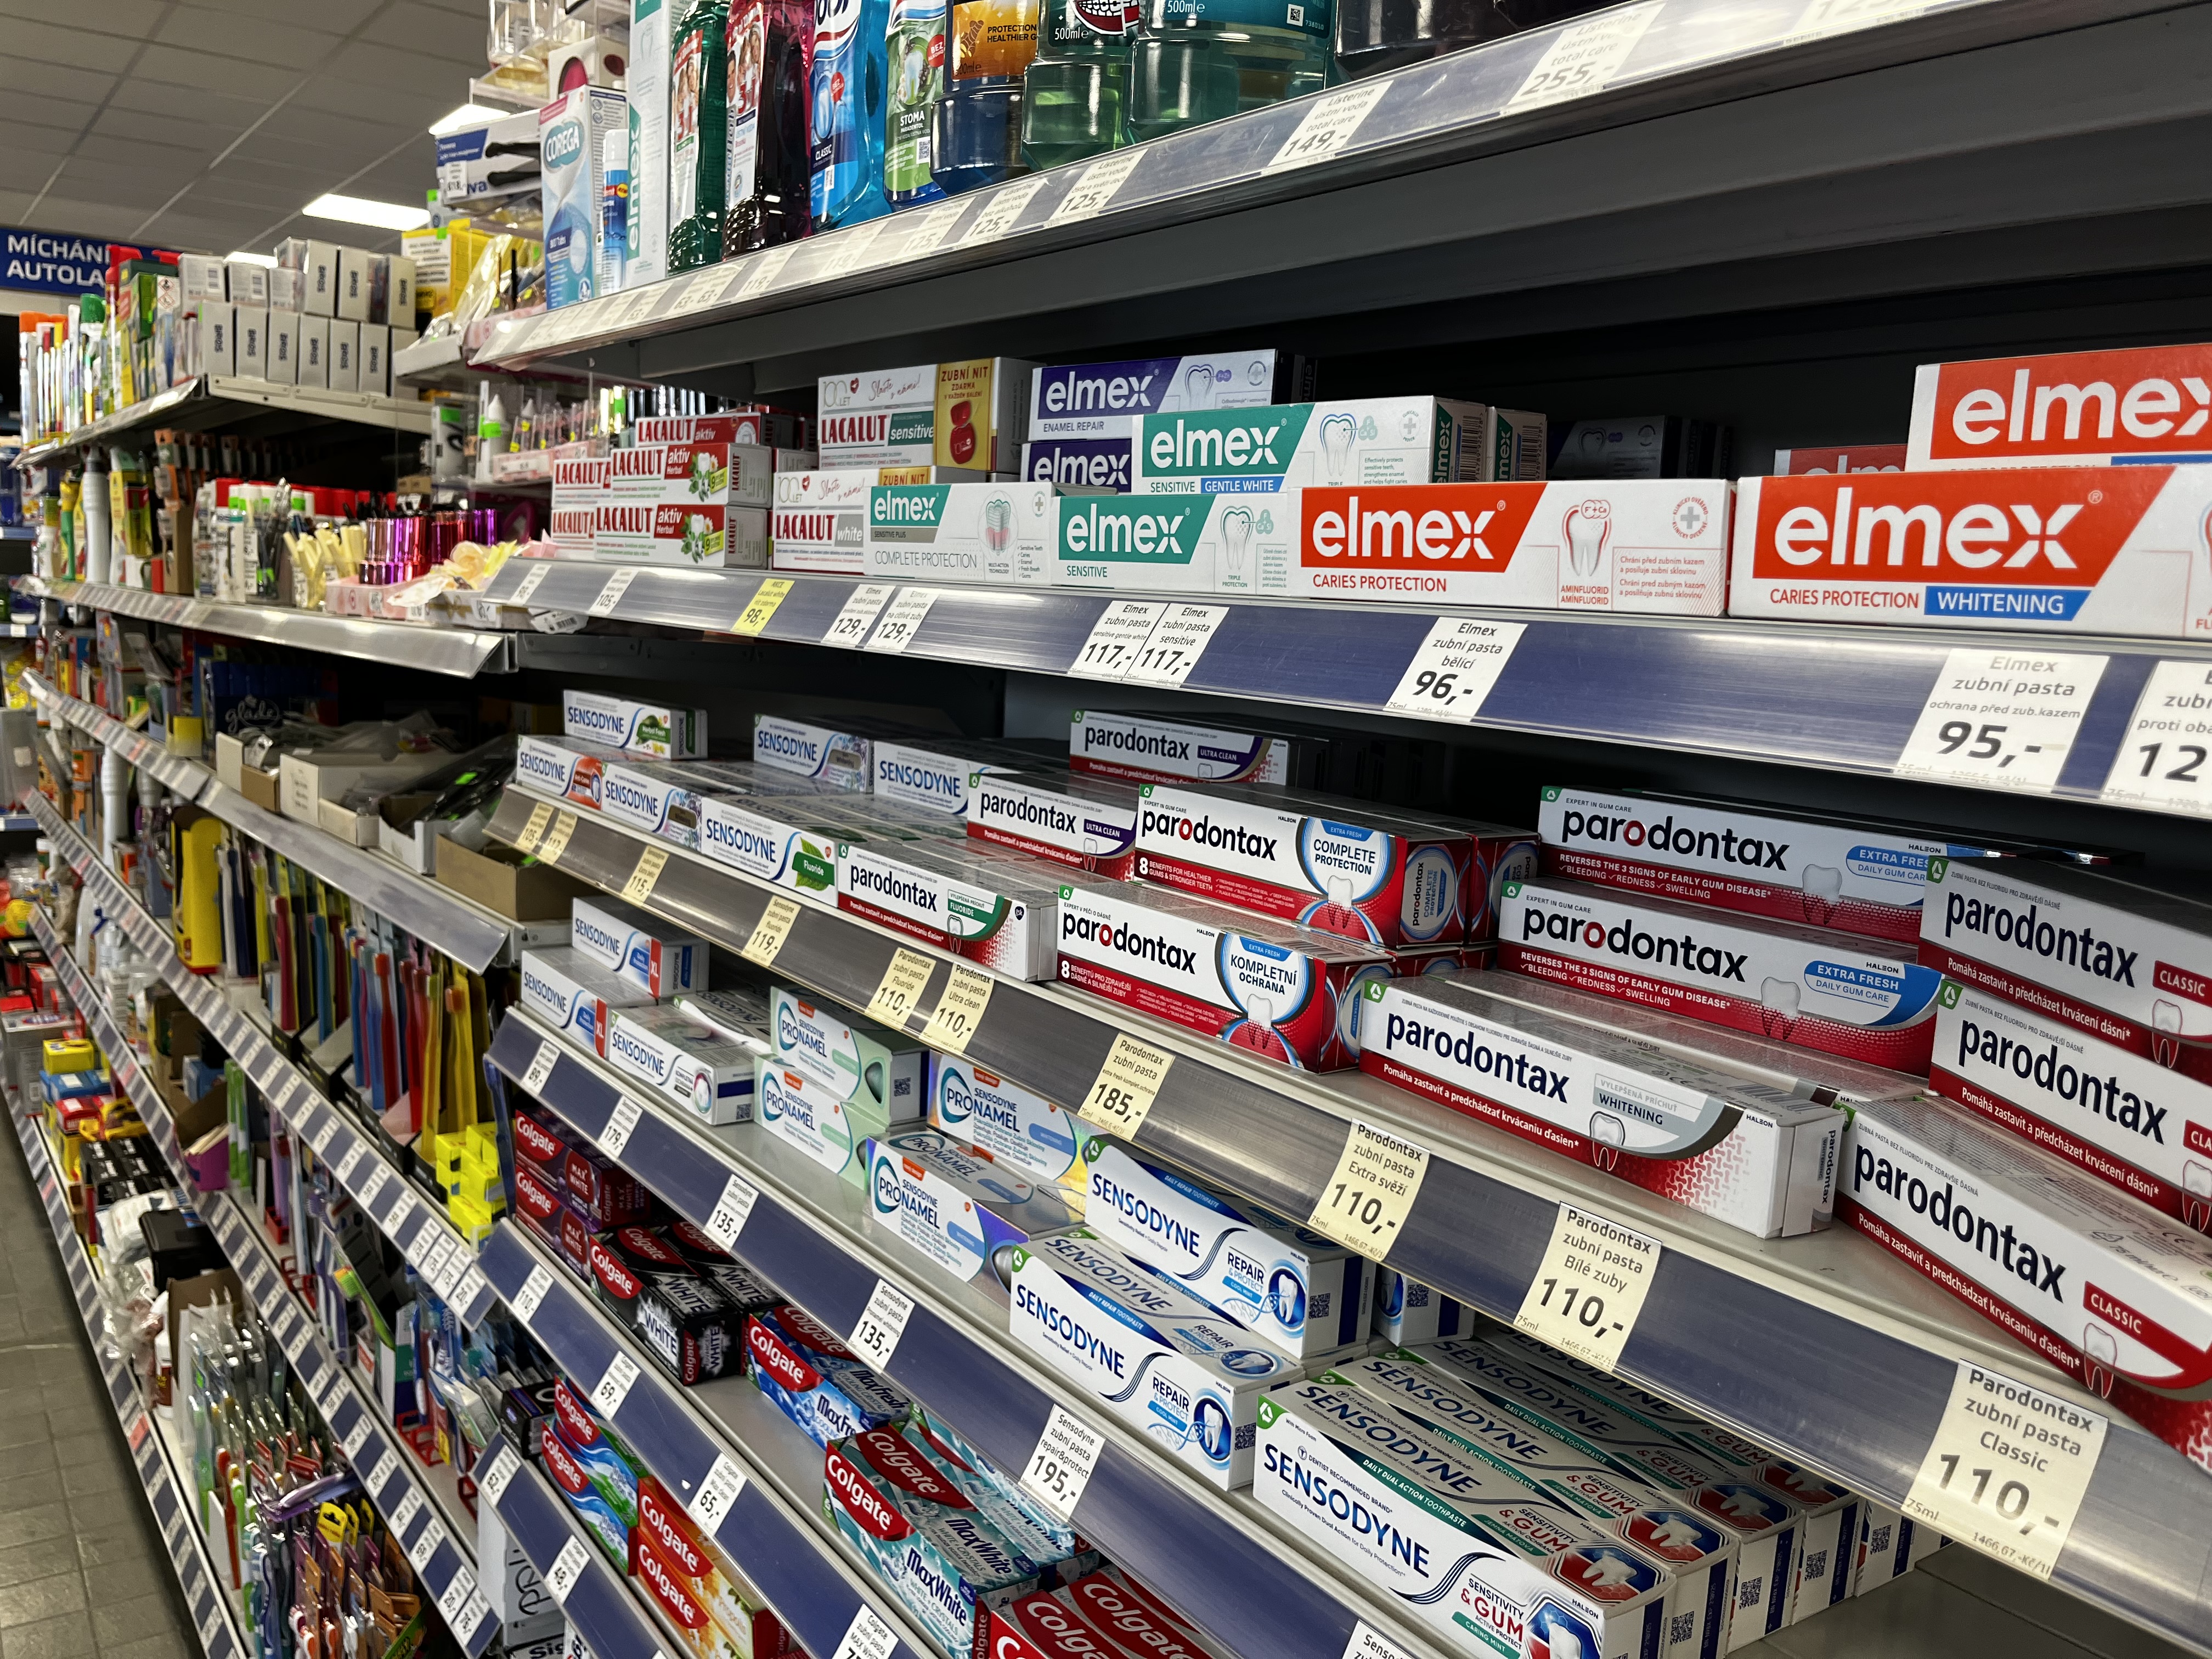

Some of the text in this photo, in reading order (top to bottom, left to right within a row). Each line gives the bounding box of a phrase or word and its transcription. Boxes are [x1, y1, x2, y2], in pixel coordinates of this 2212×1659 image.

[987, 32, 1029, 43] HEALTHIER
[988, 24, 1036, 33] PROTECTION
[1577, 12, 1643, 36] Listerine
[1550, 42, 1618, 67] total care
[1521, 61, 1615, 97] 255,-
[1328, 87, 1375, 107] Listerine
[900, 110, 924, 126] STOMA
[545, 124, 581, 164] COREGA
[1284, 129, 1347, 157] 149,-
[628, 120, 641, 251] elmex
[1061, 191, 1109, 213] 125,-
[7, 259, 105, 289] AUTOLA
[941, 366, 988, 382] ZUBNÍ NIT
[639, 419, 716, 442] LACALUT aktiv
[822, 415, 934, 444] LACALUT sensitive
[1043, 421, 1104, 432] ENAMEL REPAIR
[1150, 419, 1280, 469] elmex
[555, 463, 603, 485] LACALUT
[613, 449, 690, 476] LACALUT aktiv
[1150, 480, 1274, 493] SENSITIVE GENTLE WHITE
[596, 507, 682, 533] LACALUT aktiv
[873, 496, 936, 522] elmex
[776, 514, 862, 542] LACALUT white
[1066, 504, 1184, 554] elmex
[1312, 496, 1496, 560] elmex
[1775, 487, 2084, 569] elmex
[876, 551, 977, 568] COMPLETE PROTECTION
[1067, 566, 1108, 578] SENSITIVE
[1312, 574, 1447, 592] CARIES PROTECTION
[1561, 585, 1609, 595] AMINFLUORID
[1123, 605, 1149, 614] Elmex
[1181, 607, 1209, 618] Elmex
[1770, 589, 2063, 614] CARIES PROTECTION WHITENING
[1159, 635, 1196, 646] sensitive
[1432, 638, 1503, 654] zubní pasta
[1457, 623, 1498, 636] Elmex
[1441, 655, 1477, 669] bělící
[1989, 655, 2059, 673] Elmex
[1412, 670, 1474, 706] 96,-
[1951, 678, 2076, 697] zubní pasta
[568, 707, 625, 735] SENSODYNE
[758, 730, 817, 763] SENSODYNE
[1200, 748, 1237, 761] ULTRA CLEAN
[1937, 720, 2042, 768] 95,-
[520, 752, 565, 783] SENSODYNE
[879, 760, 961, 798] SENSODYNE
[606, 780, 658, 817] SENSODYNE
[706, 818, 777, 864] SENSODYNE
[1086, 822, 1120, 838] ULTRA CLEAN
[1561, 809, 1790, 872] parodontax
[804, 859, 824, 877] Fluoride
[1313, 839, 1376, 864] COMPLETE
[1315, 854, 1372, 875] PROTECTION
[851, 864, 937, 912] parodontax
[1560, 854, 1601, 867] REVERSES
[1604, 862, 1620, 871] THE
[1629, 866, 1656, 878] SIGNS
[1657, 871, 1669, 879] OF
[1672, 873, 1700, 886] EARLY
[1702, 879, 1724, 890] GUM
[1567, 866, 1711, 899] BLEEDING REDNESS SWELLING
[950, 902, 974, 917] FLUORIDE
[1249, 944, 1280, 958] EXTRA FRESH
[1523, 907, 1748, 983] parodontax
[1945, 891, 2138, 989] parodontax
[956, 964, 991, 984] Parodontax
[1231, 953, 1299, 986] KOMPLETNÍ
[1239, 973, 1285, 996] OCHRANA
[1818, 964, 1899, 990] EXTRA FRESH
[2159, 970, 2206, 997] CLASSIC
[1816, 980, 1889, 1002] DAILY GUM CARE
[612, 1031, 665, 1077] SENSODYNE
[782, 1020, 827, 1059] PRONAMEL
[1120, 1040, 1164, 1066] Parodontax
[1113, 1055, 1158, 1080] zubní pasta
[1386, 1012, 1570, 1105] parodontax
[1958, 1019, 2168, 1146] parodontax
[766, 1091, 816, 1131] PRONAMEL
[946, 1087, 1020, 1134] PRONAMEL
[1094, 1084, 1142, 1123] 185,-
[1598, 1092, 1664, 1126] WHITENING
[1357, 1124, 1422, 1162] Parodontax
[1348, 1161, 1408, 1197] Extra svěží
[879, 1176, 940, 1230] PRONAMEL
[1092, 1173, 1200, 1257] SENSODYNE
[1331, 1183, 1396, 1234] 110,-
[1567, 1209, 1652, 1255] Parodontax
[1854, 1144, 2067, 1303] parodontax
[591, 1245, 633, 1295] Colgate
[1228, 1251, 1264, 1284] REPAIR
[1234, 1271, 1263, 1294] PROTECT
[1564, 1254, 1628, 1293] Bílé zuby
[1540, 1278, 1624, 1338] 110,-
[2091, 1293, 2142, 1334] CLASSIC
[646, 1313, 677, 1356] WHITE
[859, 1321, 890, 1357] 135,-
[1015, 1284, 1125, 1379] SENSODYNE
[750, 1324, 807, 1384] Colgate
[1153, 1375, 1189, 1412] REPAIR
[1969, 1368, 2094, 1433] Parodontax
[554, 1387, 594, 1443] Colgate
[1058, 1414, 1094, 1446] Sensodyne
[1964, 1397, 2082, 1457] zubní pasta
[542, 1434, 582, 1489] Colgate
[1040, 1438, 1089, 1479] repair&protect
[1050, 1427, 1091, 1461] zubní pasta
[1980, 1430, 2049, 1472] Classic
[867, 1432, 940, 1493] Colgate
[1034, 1455, 1076, 1501] 195,-
[827, 1454, 890, 1531] Colgate
[1363, 1459, 1466, 1528] DAILY DUAL ACTION TOOTHPASTE
[1939, 1453, 2060, 1536] 110,-
[1263, 1443, 1430, 1578] SENSODYNE
[1519, 1508, 1578, 1544] SENSITIVITY
[640, 1493, 699, 1573] Colgate
[1513, 1517, 1570, 1552] GUM
[637, 1542, 696, 1624] Colgate
[1469, 1578, 1524, 1620] SENSITIVITY
[1465, 1621, 1506, 1652] CARING MINT
[1475, 1615, 1522, 1650] ACTIVE PROTECT
